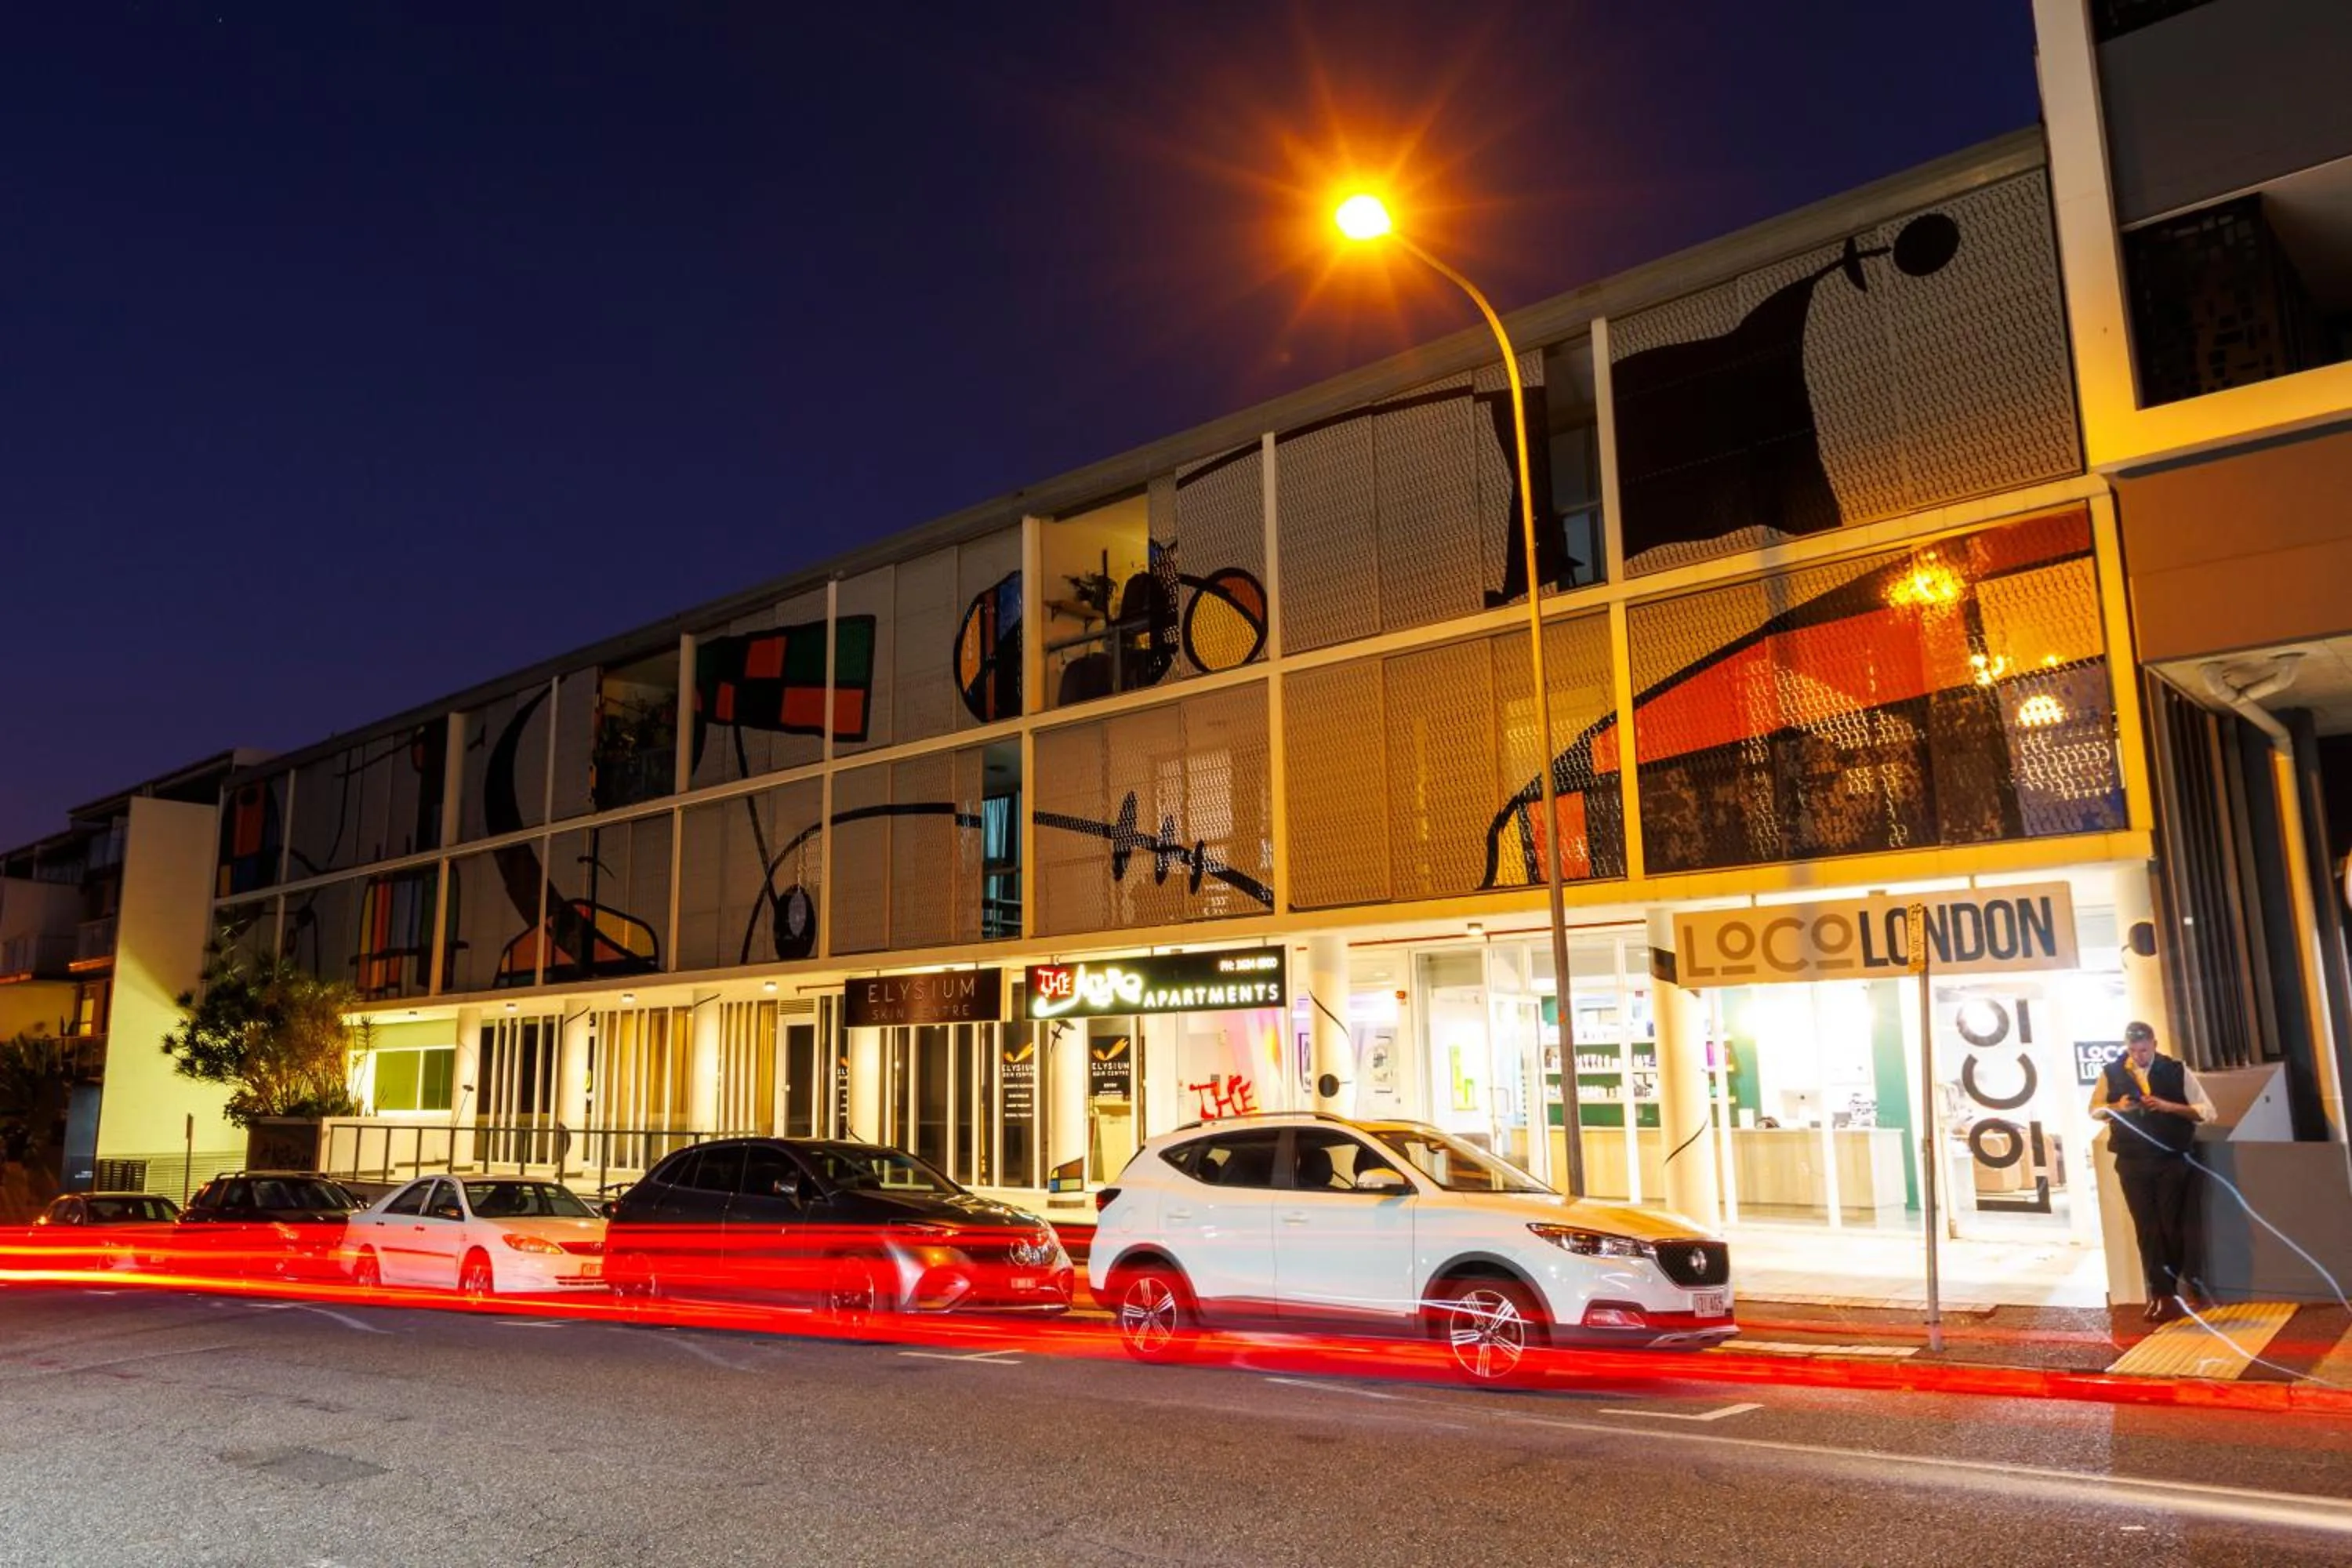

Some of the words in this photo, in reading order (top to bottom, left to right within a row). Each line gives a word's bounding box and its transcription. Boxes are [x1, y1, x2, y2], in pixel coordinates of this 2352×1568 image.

[1858, 896, 2056, 968] LONDON
[868, 978, 975, 1004] ELYSIUM
[1144, 984, 1279, 1007] APARTMENTS
[872, 1008, 905, 1020] SKIN
[914, 1004, 971, 1018] ENTRE
[1189, 1075, 1258, 1119] THE
